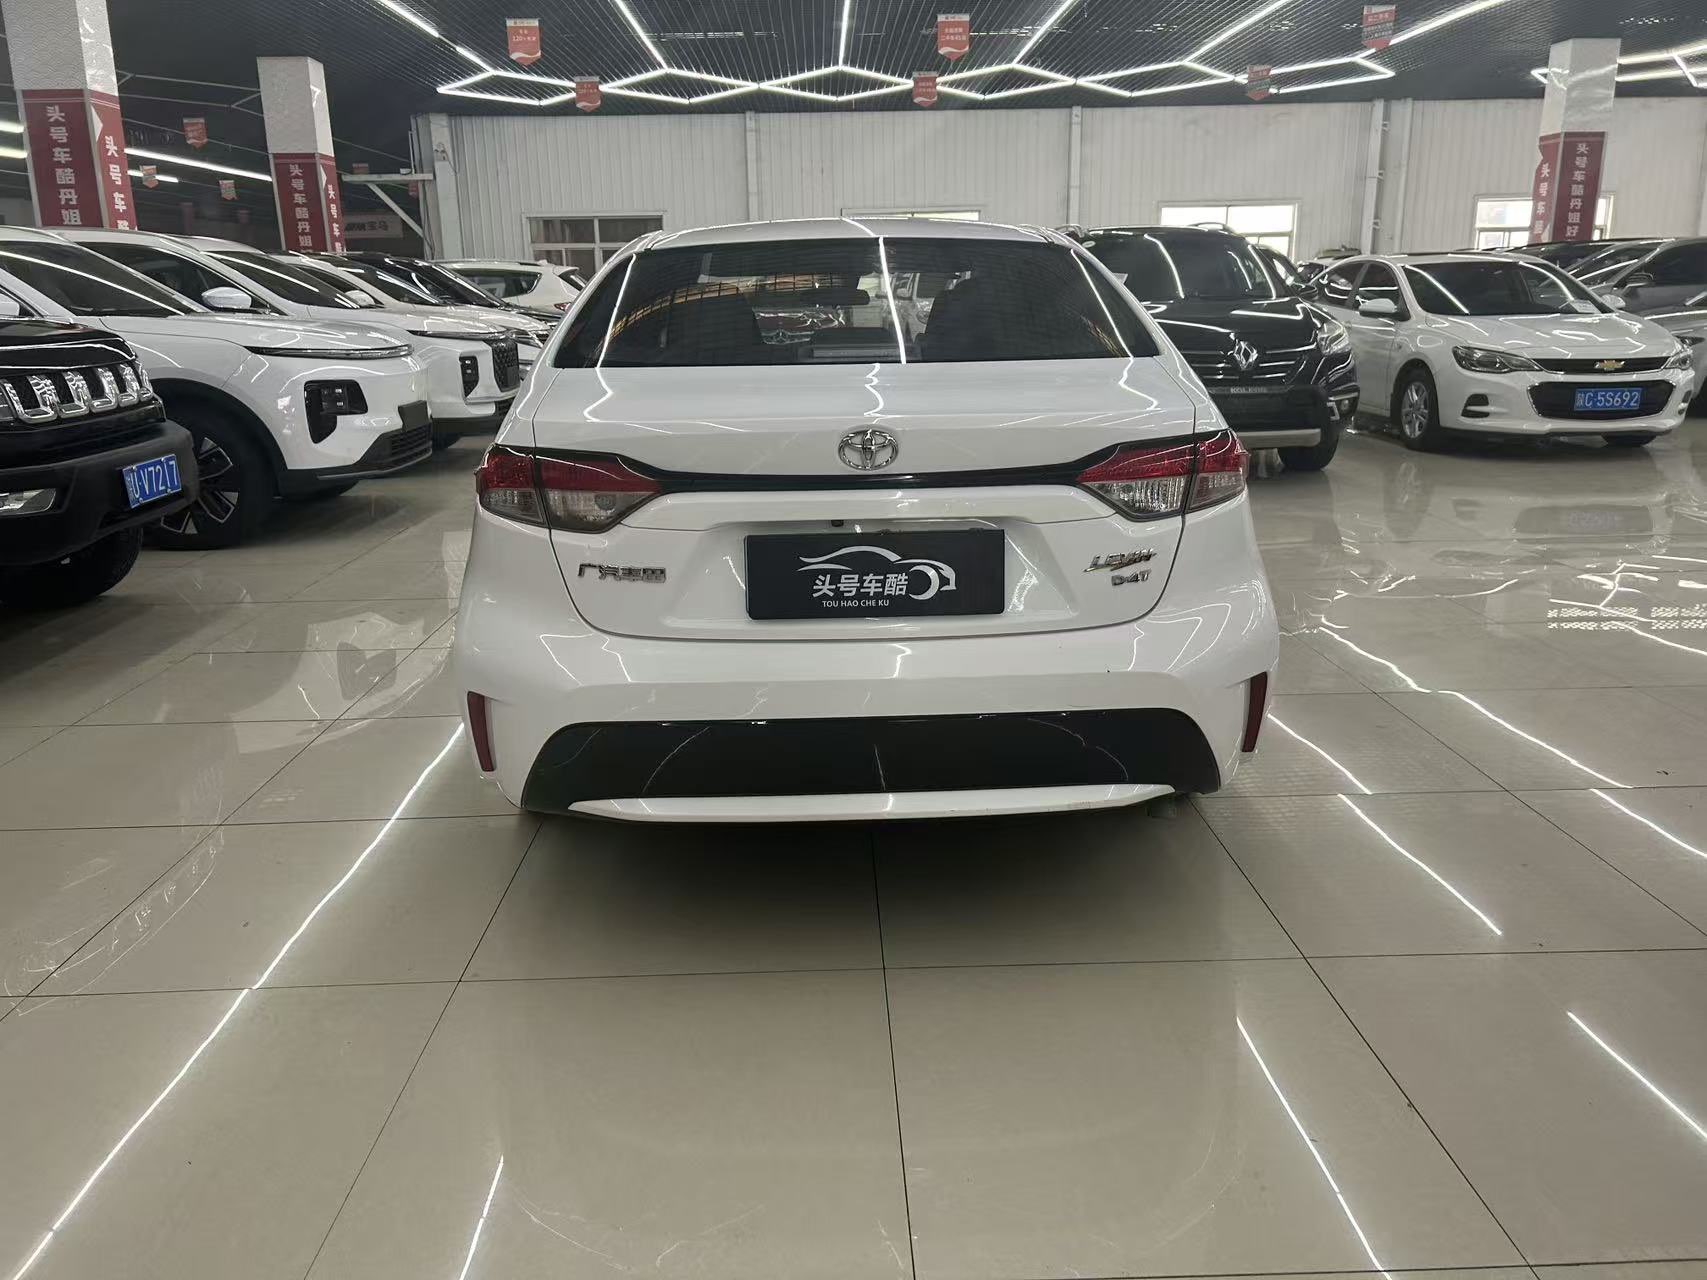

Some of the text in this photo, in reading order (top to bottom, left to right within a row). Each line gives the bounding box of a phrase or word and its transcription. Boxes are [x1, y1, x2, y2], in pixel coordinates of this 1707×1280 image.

[45, 104, 83, 225] 头号车酷丹姐
[289, 163, 314, 253] 头号车酷丹姐
[812, 572, 909, 598] 头号车酷
[860, 599, 877, 607] CHE
